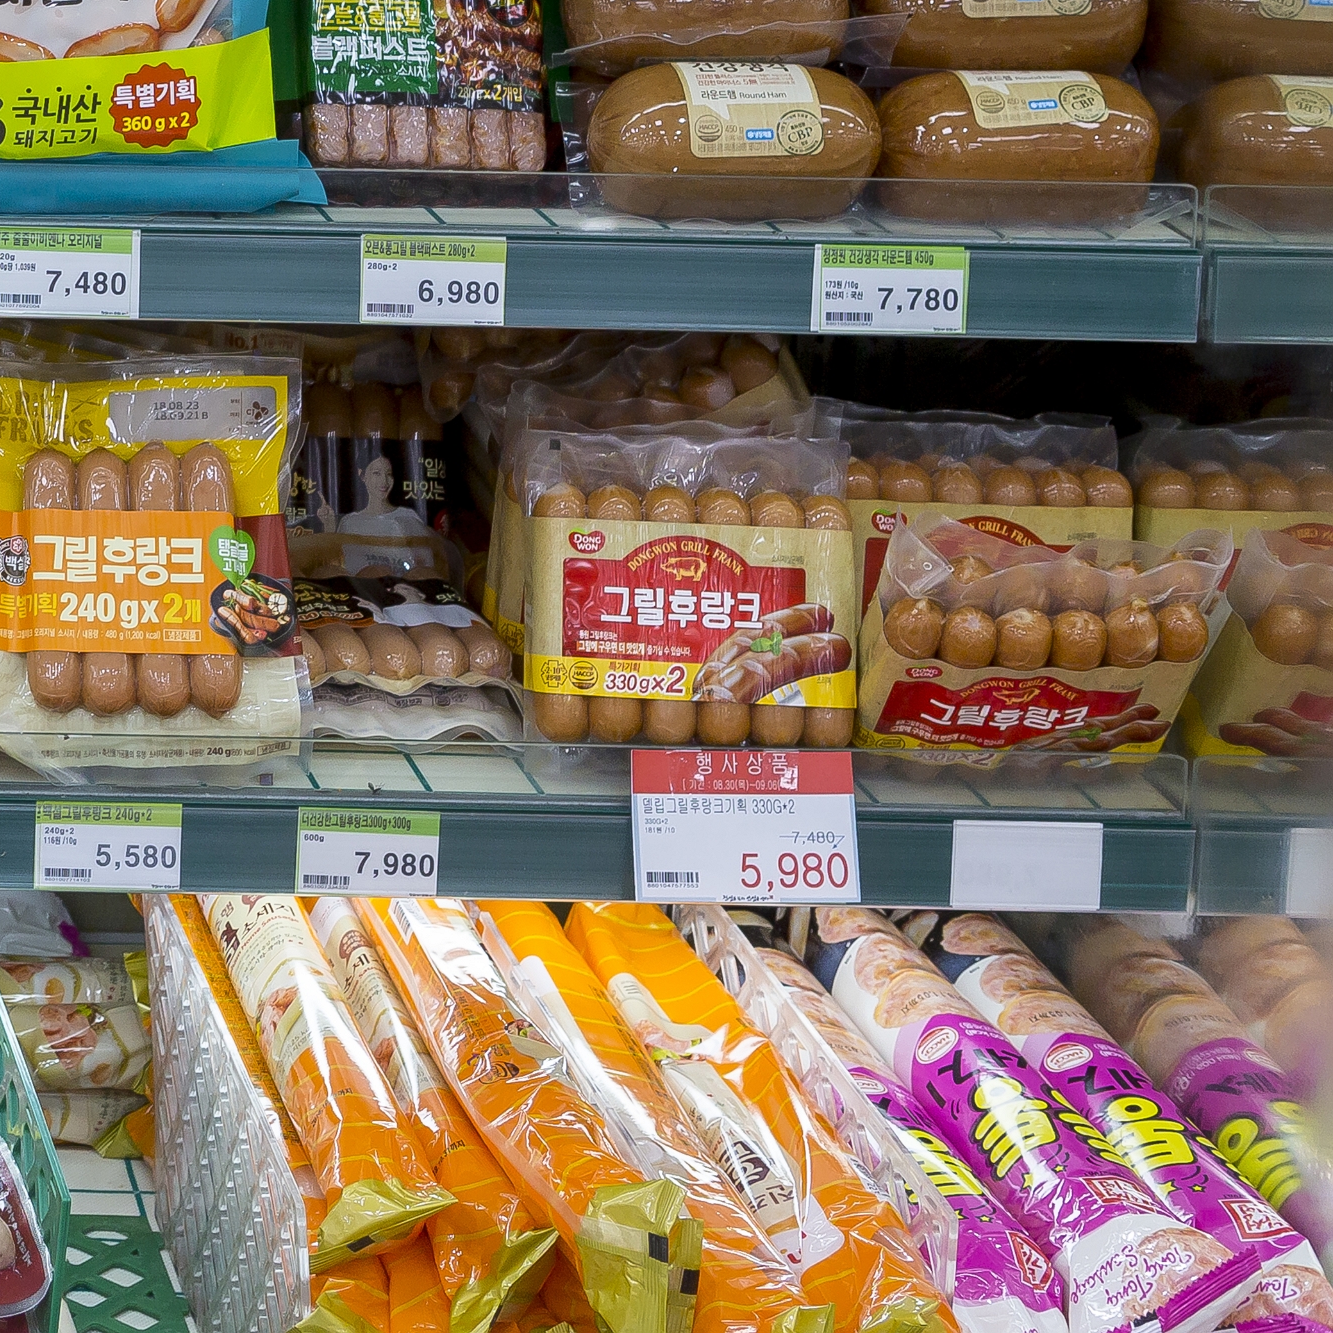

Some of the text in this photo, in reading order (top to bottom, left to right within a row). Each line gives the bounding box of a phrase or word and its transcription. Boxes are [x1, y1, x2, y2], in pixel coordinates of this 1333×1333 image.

[113, 82, 197, 107] 특별기획
[11, 91, 103, 126] 국내산
[12, 124, 99, 148] 돼지고기
[47, 271, 126, 296] 7,480
[419, 280, 498, 306] 6,980
[878, 288, 958, 313] 7,780
[35, 534, 205, 586] 그릴 후랑크
[599, 583, 765, 629] 그릴후랑크
[921, 696, 1090, 735] 그릴후랑크
[304, 834, 324, 843] 600g
[790, 832, 835, 844] 7,480
[96, 844, 176, 870] 5,580
[355, 852, 434, 878] 7,980
[742, 853, 848, 892] 5,980
